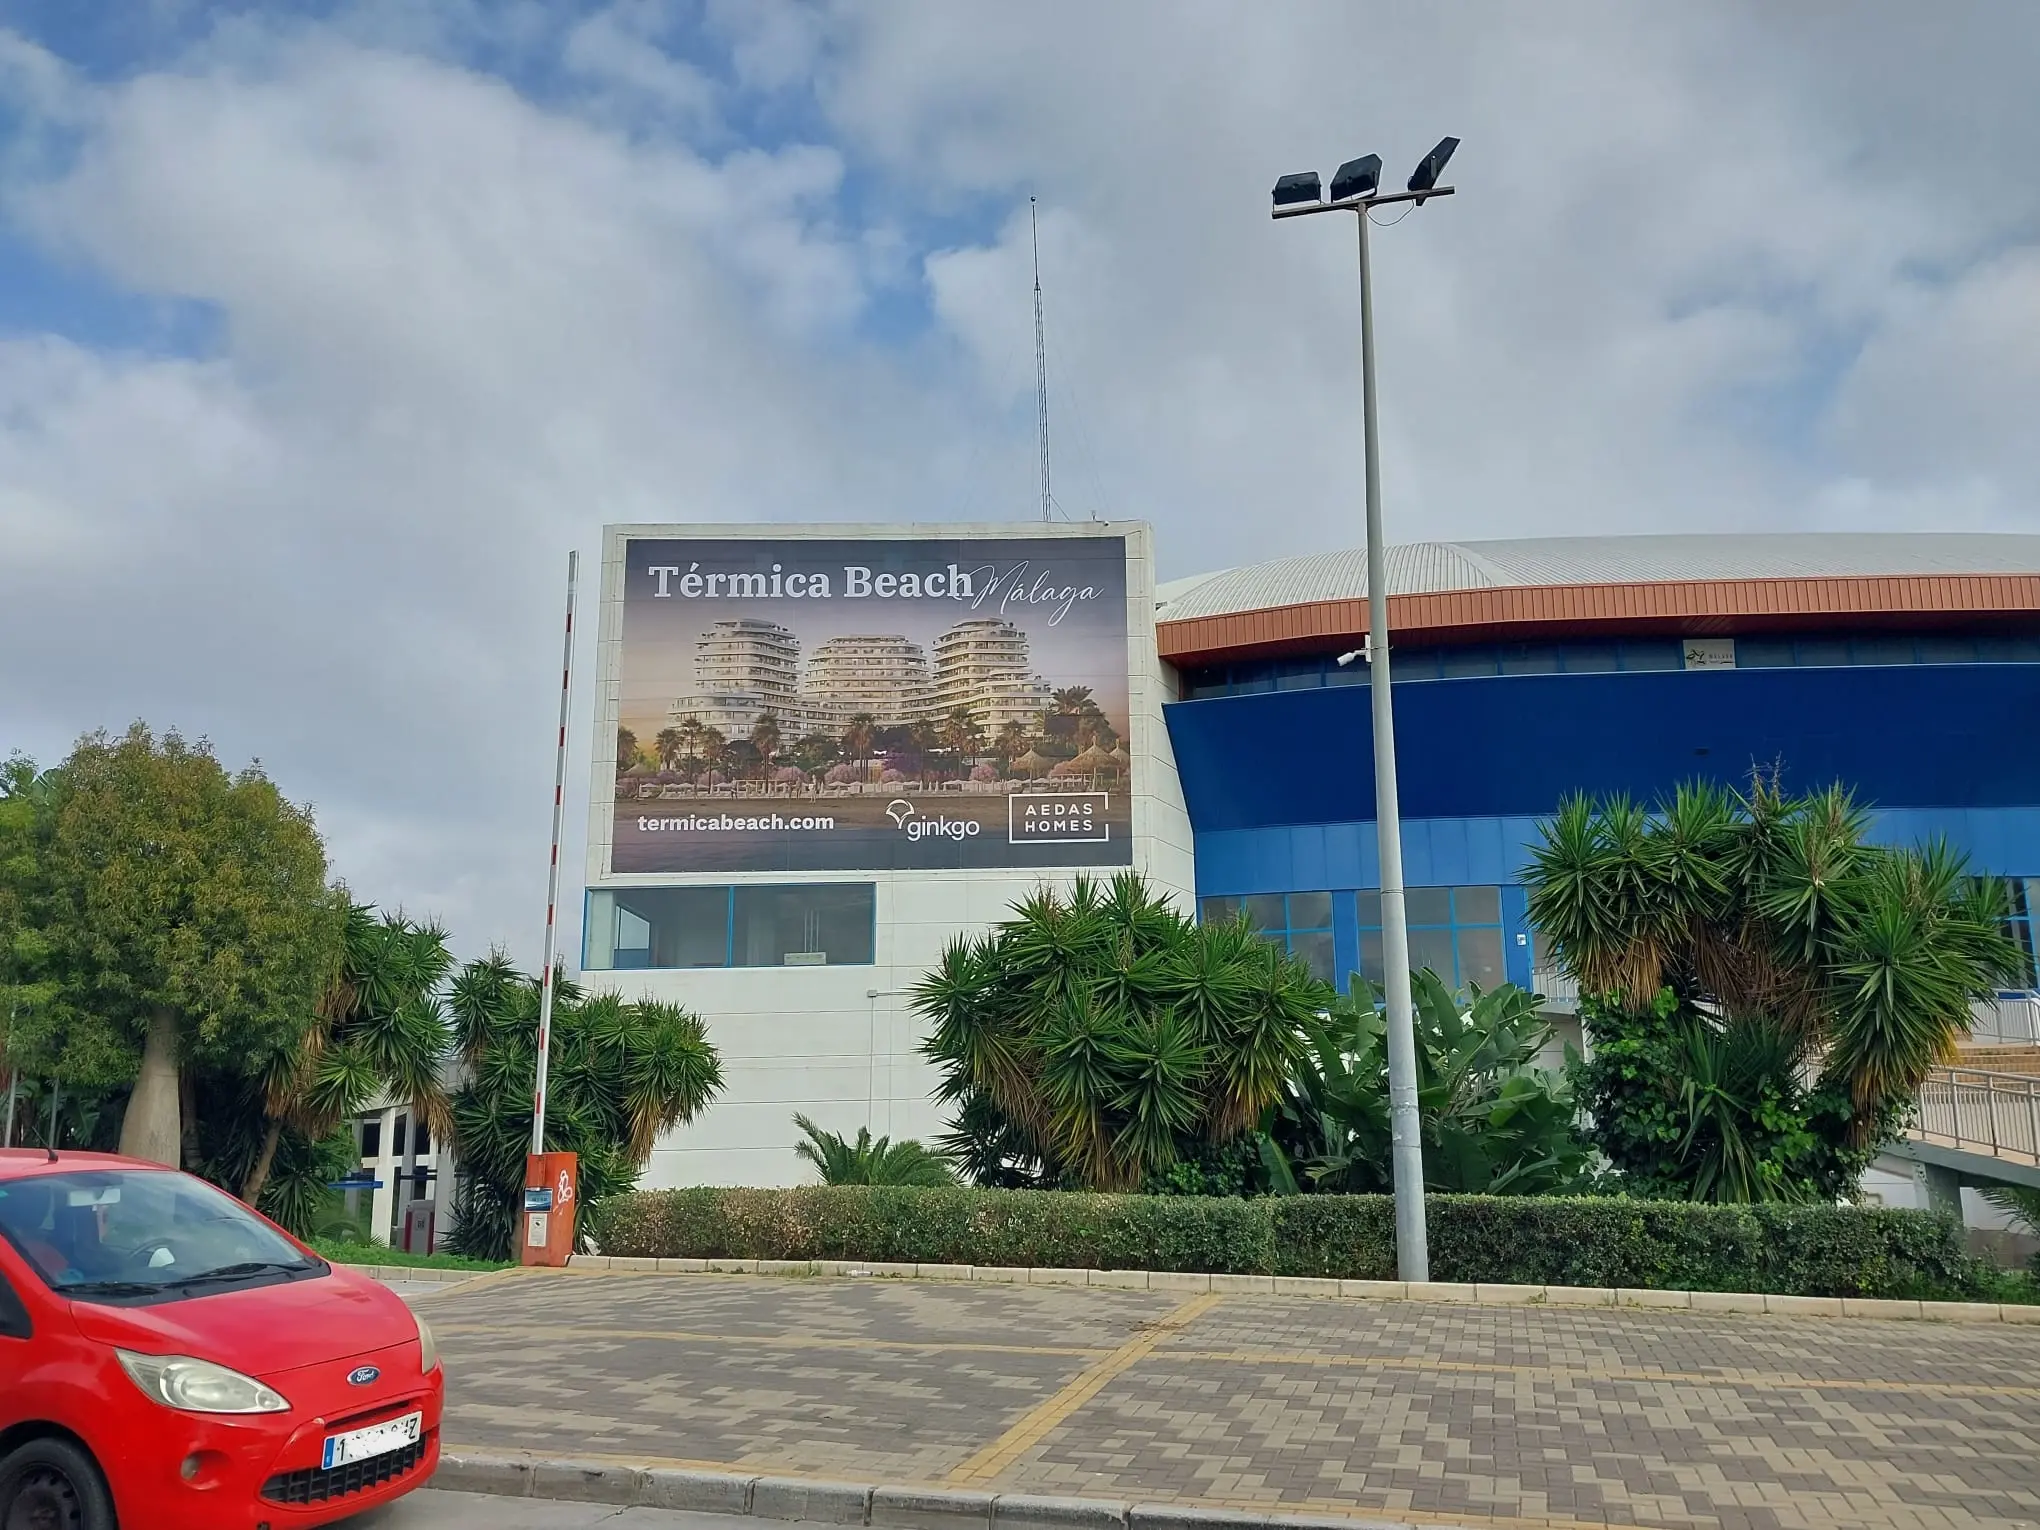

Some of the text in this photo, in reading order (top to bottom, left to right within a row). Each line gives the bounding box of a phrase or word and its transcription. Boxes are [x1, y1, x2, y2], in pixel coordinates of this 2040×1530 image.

[648, 560, 1104, 626] Térmica Beach Málaga
[1025, 803, 1093, 816] AEDAS
[637, 813, 834, 832] termicabeach.com
[907, 815, 980, 842] ginkgo
[1025, 819, 1093, 833] HOMES
[356, 1368, 375, 1382] Ford
